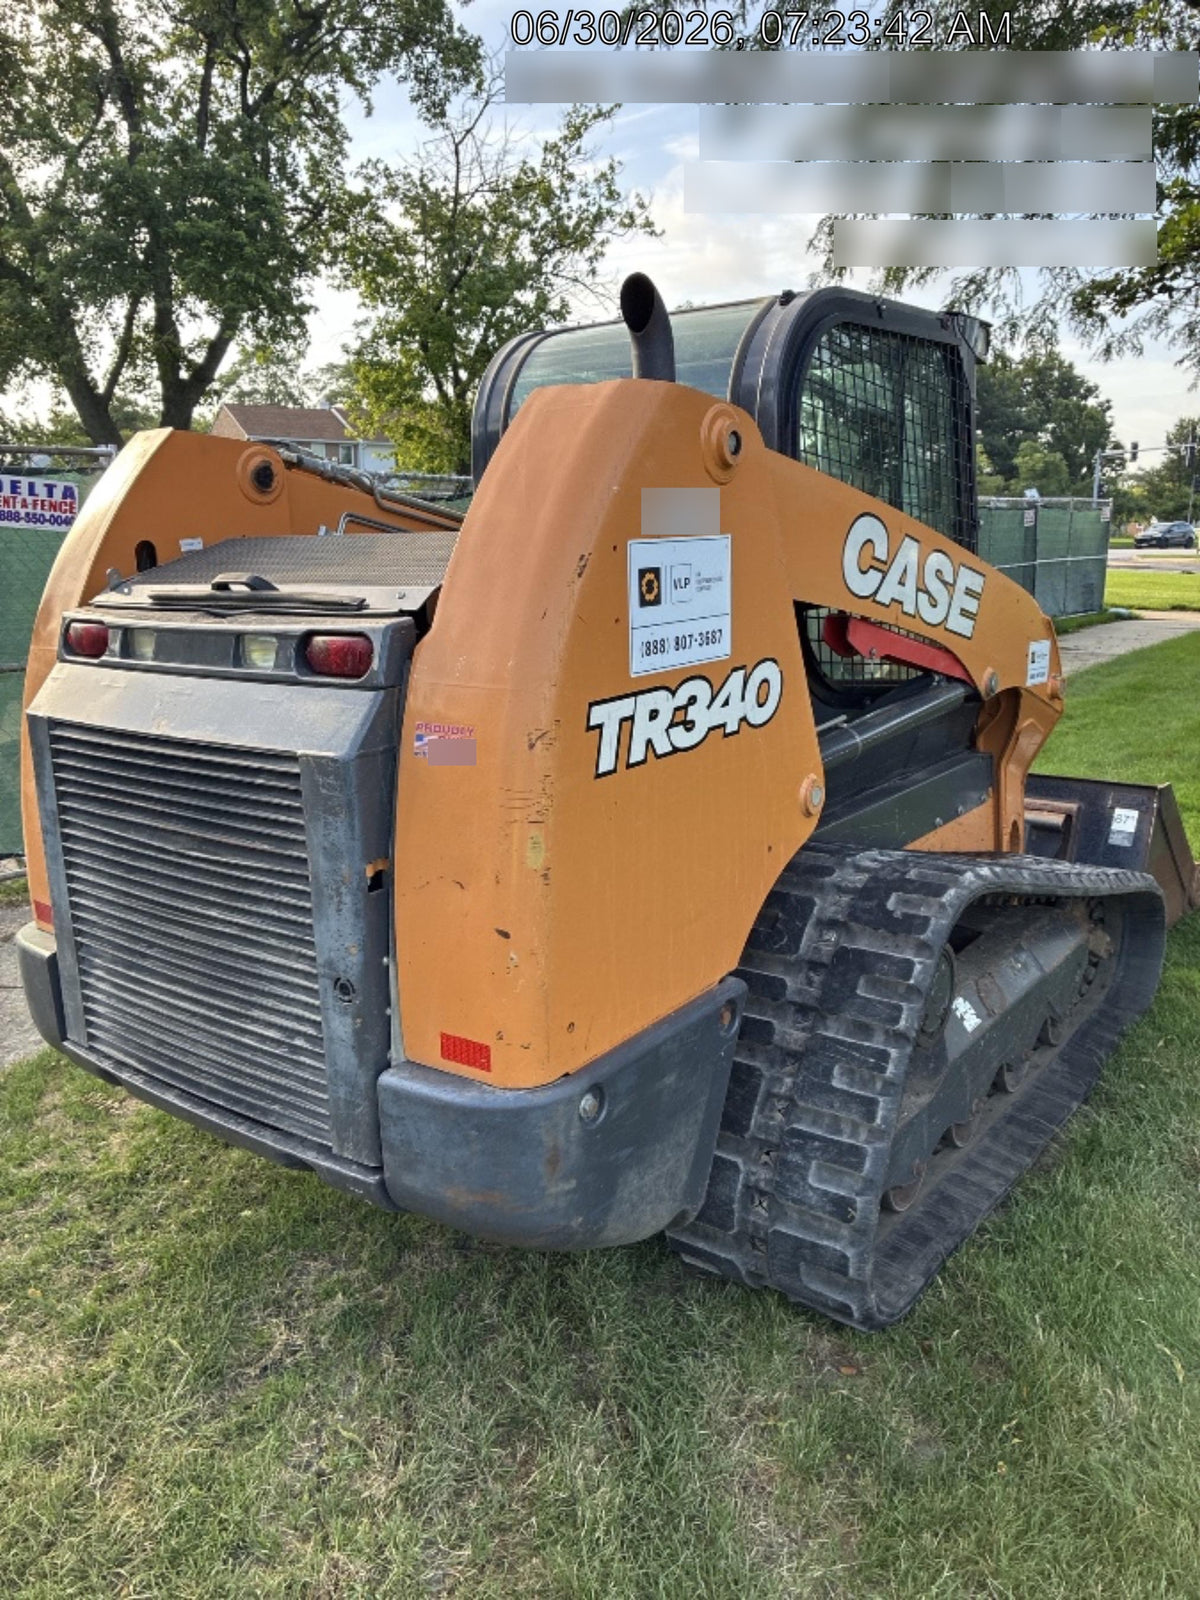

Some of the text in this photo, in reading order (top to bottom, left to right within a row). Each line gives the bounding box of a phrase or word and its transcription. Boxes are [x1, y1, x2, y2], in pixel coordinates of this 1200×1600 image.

[673, 576, 691, 590] VLP
[842, 512, 986, 640] CASE
[641, 637, 670, 658] (888)
[585, 657, 783, 779] TR340
